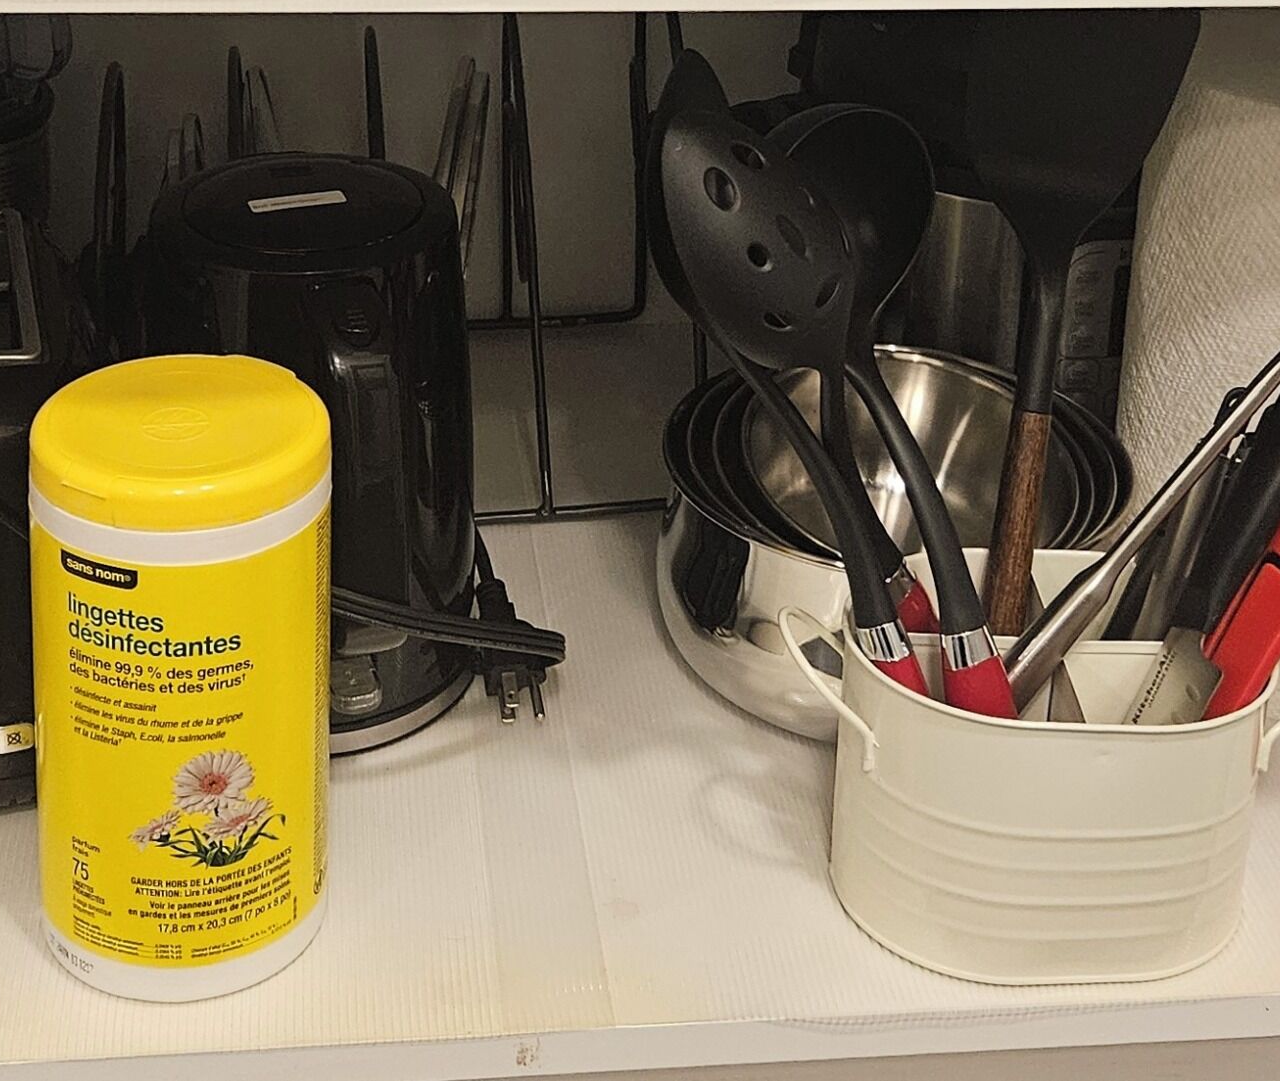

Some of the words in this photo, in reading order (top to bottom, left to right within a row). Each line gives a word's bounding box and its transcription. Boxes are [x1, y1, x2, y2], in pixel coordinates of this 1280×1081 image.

[66, 557, 94, 576] sans
[68, 591, 164, 633] lingettes
[68, 619, 242, 657] désinfectantes
[69, 647, 111, 671] élimine
[114, 661, 143, 678] 99,9
[147, 665, 162, 680] %
[166, 667, 193, 680] des
[197, 659, 254, 681] germes,
[69, 662, 90, 679] des
[92, 670, 155, 693] bactéries
[159, 682, 174, 694] et
[177, 681, 204, 694] des
[73, 686, 112, 705] désinfecte
[113, 699, 122, 707] et
[73, 726, 81, 734] et
[82, 728, 89, 737] la
[101, 710, 113, 720] les
[116, 713, 135, 724] virus
[137, 717, 149, 726] du
[150, 719, 178, 728] rhume
[181, 719, 190, 728] et
[192, 719, 204, 728] de
[206, 717, 214, 726] la
[216, 711, 244, 726] grippe
[101, 724, 110, 733] le
[111, 726, 137, 741] Staph,
[167, 734, 176, 743] la
[178, 730, 227, 743] salmonelle
[72, 856, 90, 881] 75
[130, 876, 163, 888] GARDER
[165, 879, 188, 888] HORS
[190, 879, 201, 887] DE
[203, 877, 214, 886] LA
[216, 867, 246, 883] PORTÉE
[247, 862, 262, 875] DES
[135, 887, 183, 897] ATTENTION:
[185, 889, 200, 897] Lire
[202, 880, 243, 895] l'étiquette
[244, 871, 265, 885] avant
[150, 900, 165, 910] Voir
[168, 902, 175, 910] le
[177, 899, 212, 912] panneau
[214, 892, 241, 906] arrière
[242, 886, 259, 899] pour
[260, 881, 271, 890] les
[128, 908, 138, 916] en
[140, 910, 167, 920] gardes
[169, 912, 177, 920] et
[179, 912, 191, 920] les
[193, 906, 228, 917] mesures
[229, 902, 239, 911] de
[241, 889, 272, 909] premiers
[158, 923, 179, 935] 17,8
[180, 924, 196, 933] cm
[198, 923, 204, 931] x
[206, 917, 227, 930] 20,3
[228, 914, 243, 925] cm
[244, 908, 253, 922] (7
[255, 905, 266, 918] po
[273, 896, 279, 907] 8
